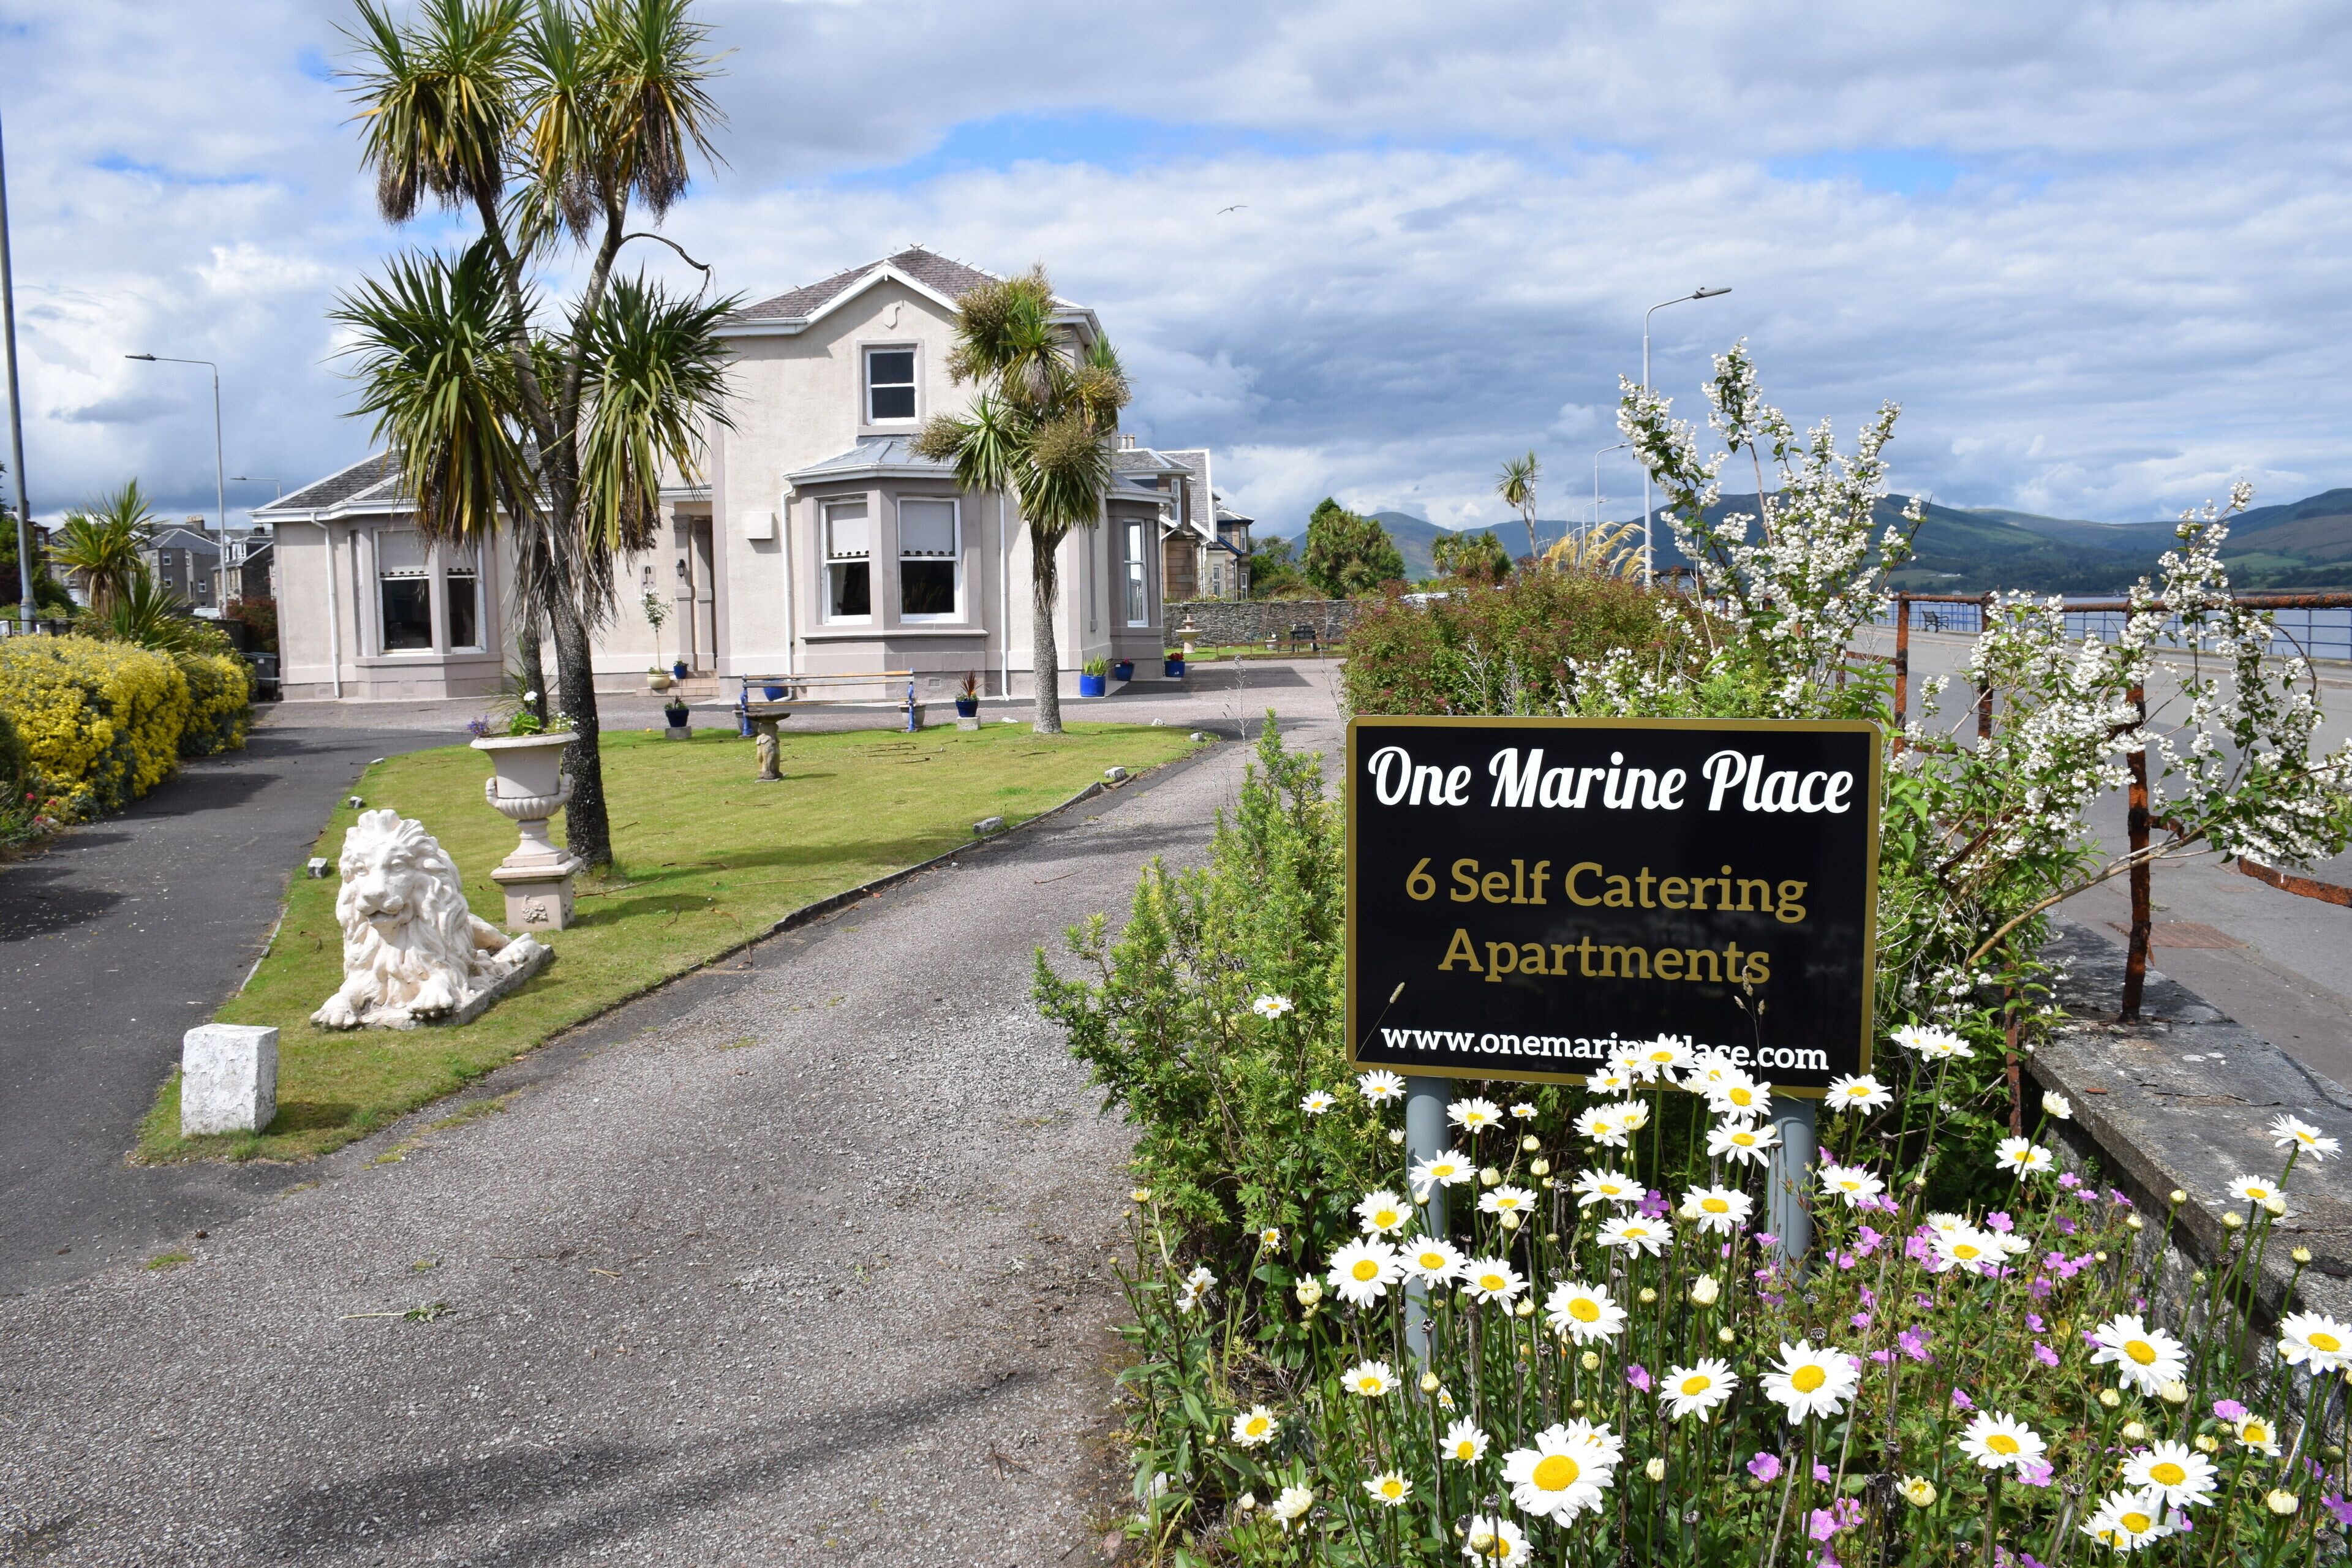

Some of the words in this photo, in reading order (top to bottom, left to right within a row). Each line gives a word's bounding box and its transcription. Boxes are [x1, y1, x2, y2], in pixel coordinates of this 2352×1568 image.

[1368, 746, 1471, 806] One
[1489, 748, 1686, 810] Marine
[1703, 750, 1853, 813] Place
[1406, 858, 1435, 900] 6
[1451, 859, 1550, 904] Self
[1566, 862, 1807, 923] Catering
[1438, 929, 1770, 984] Apartments
